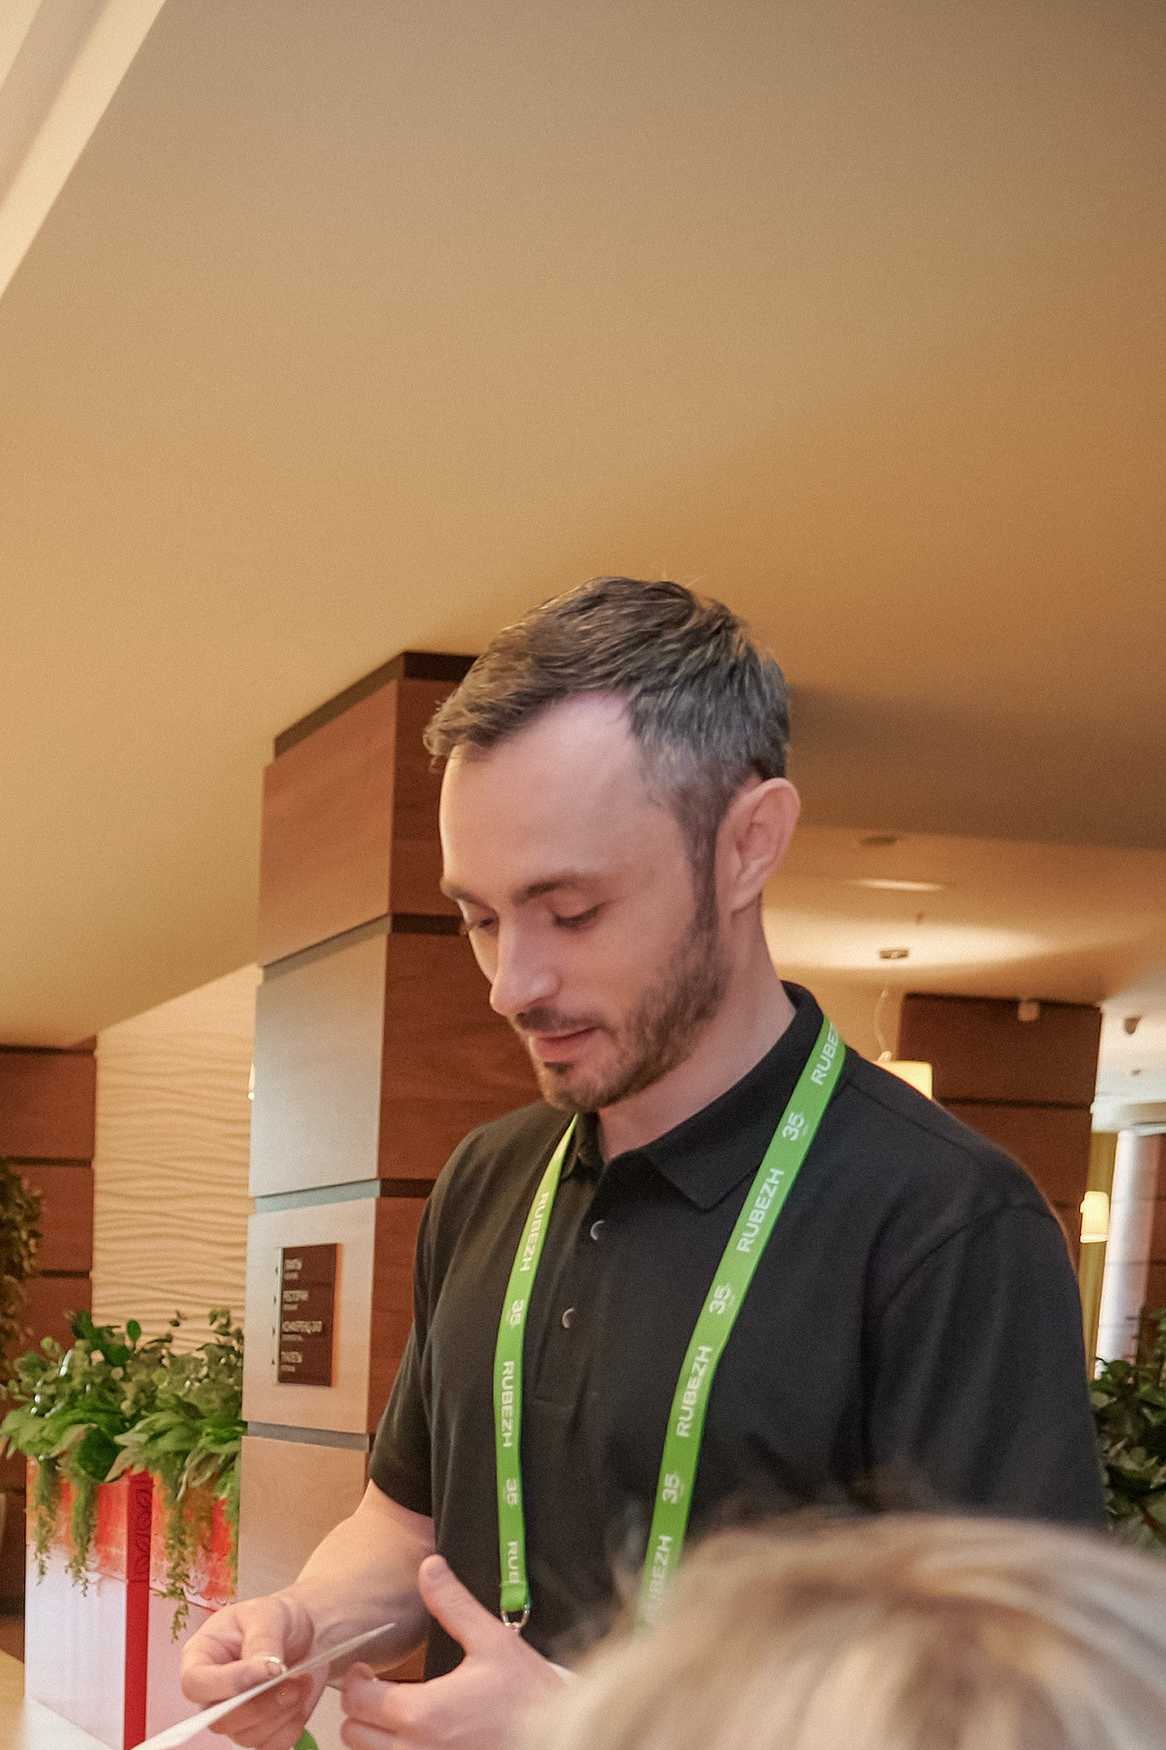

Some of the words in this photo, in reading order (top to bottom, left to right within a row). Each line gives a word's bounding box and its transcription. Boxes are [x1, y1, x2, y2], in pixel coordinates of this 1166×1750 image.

[519, 1192, 550, 1272] RUBEZH
[661, 1472, 682, 1505] 35
[676, 1345, 712, 1438] RUBEZH
[708, 1283, 732, 1315] 35
[736, 1168, 784, 1252] RUBEZH
[782, 1112, 806, 1141] 35
[501, 1360, 515, 1448] RUBEZH
